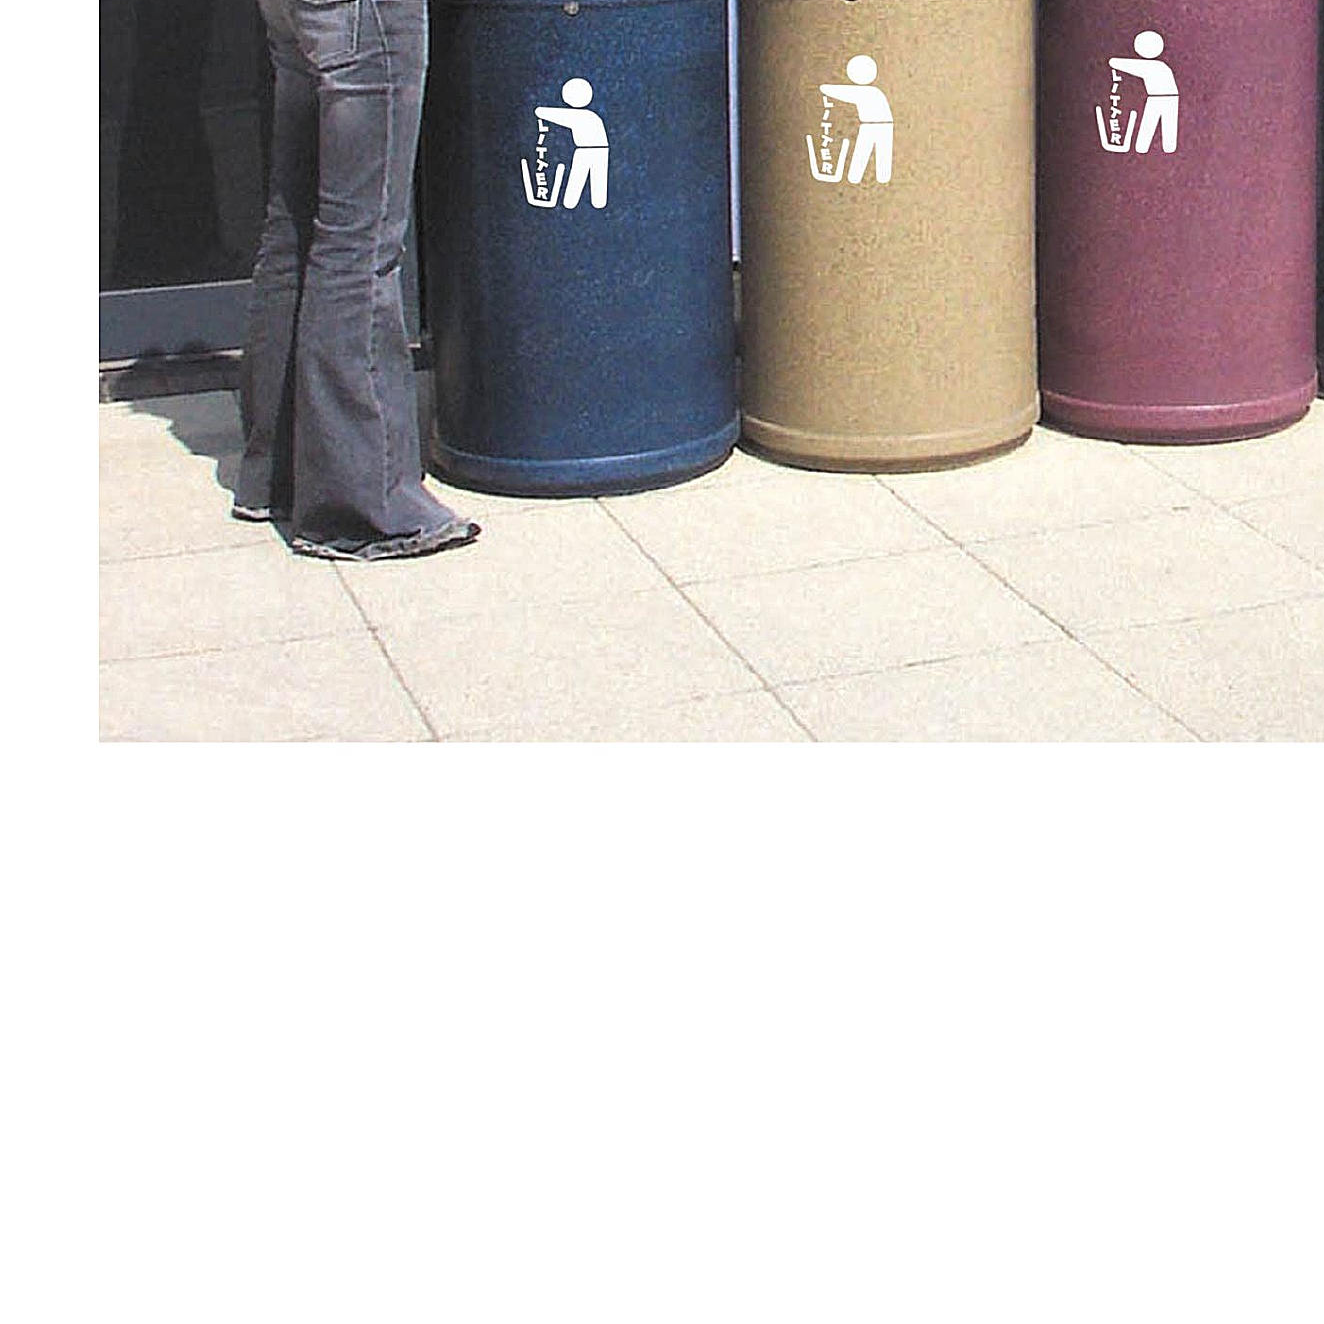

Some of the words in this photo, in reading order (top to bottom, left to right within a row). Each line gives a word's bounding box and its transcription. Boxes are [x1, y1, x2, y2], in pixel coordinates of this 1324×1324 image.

[820, 95, 834, 174] LITTER
[1109, 69, 1122, 144] LITTER
[535, 118, 549, 200] LITTER
